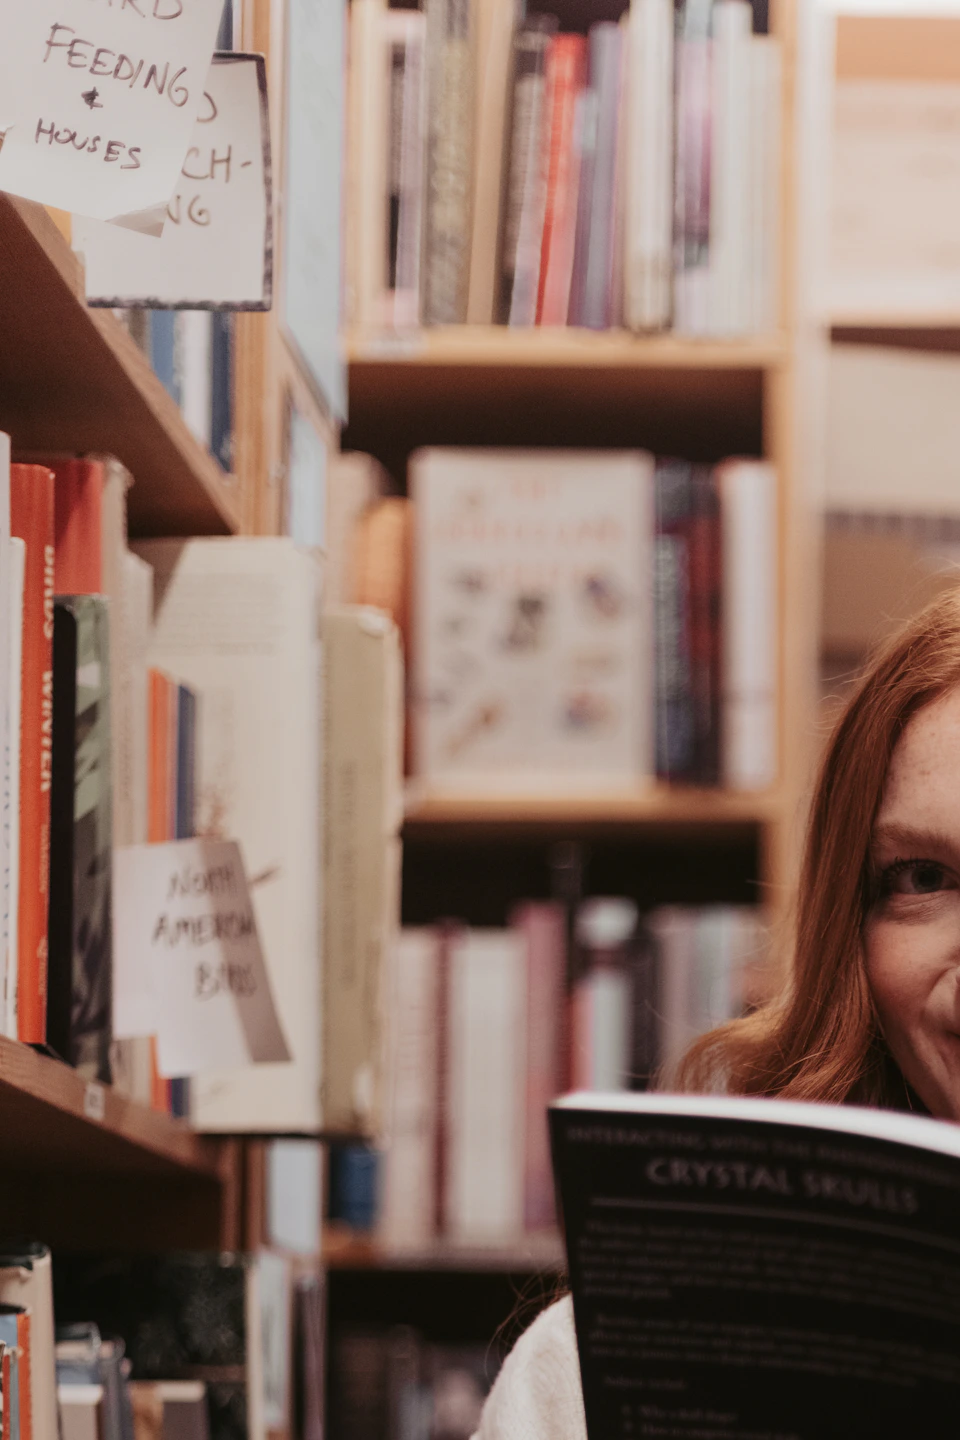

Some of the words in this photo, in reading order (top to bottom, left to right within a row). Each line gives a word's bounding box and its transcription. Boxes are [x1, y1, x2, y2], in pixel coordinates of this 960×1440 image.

[43, 22, 189, 108] FEEDING
[35, 118, 141, 169] HOUSES
[646, 1156, 793, 1197] CRYSTAL
[803, 1173, 919, 1215] SKULLS
